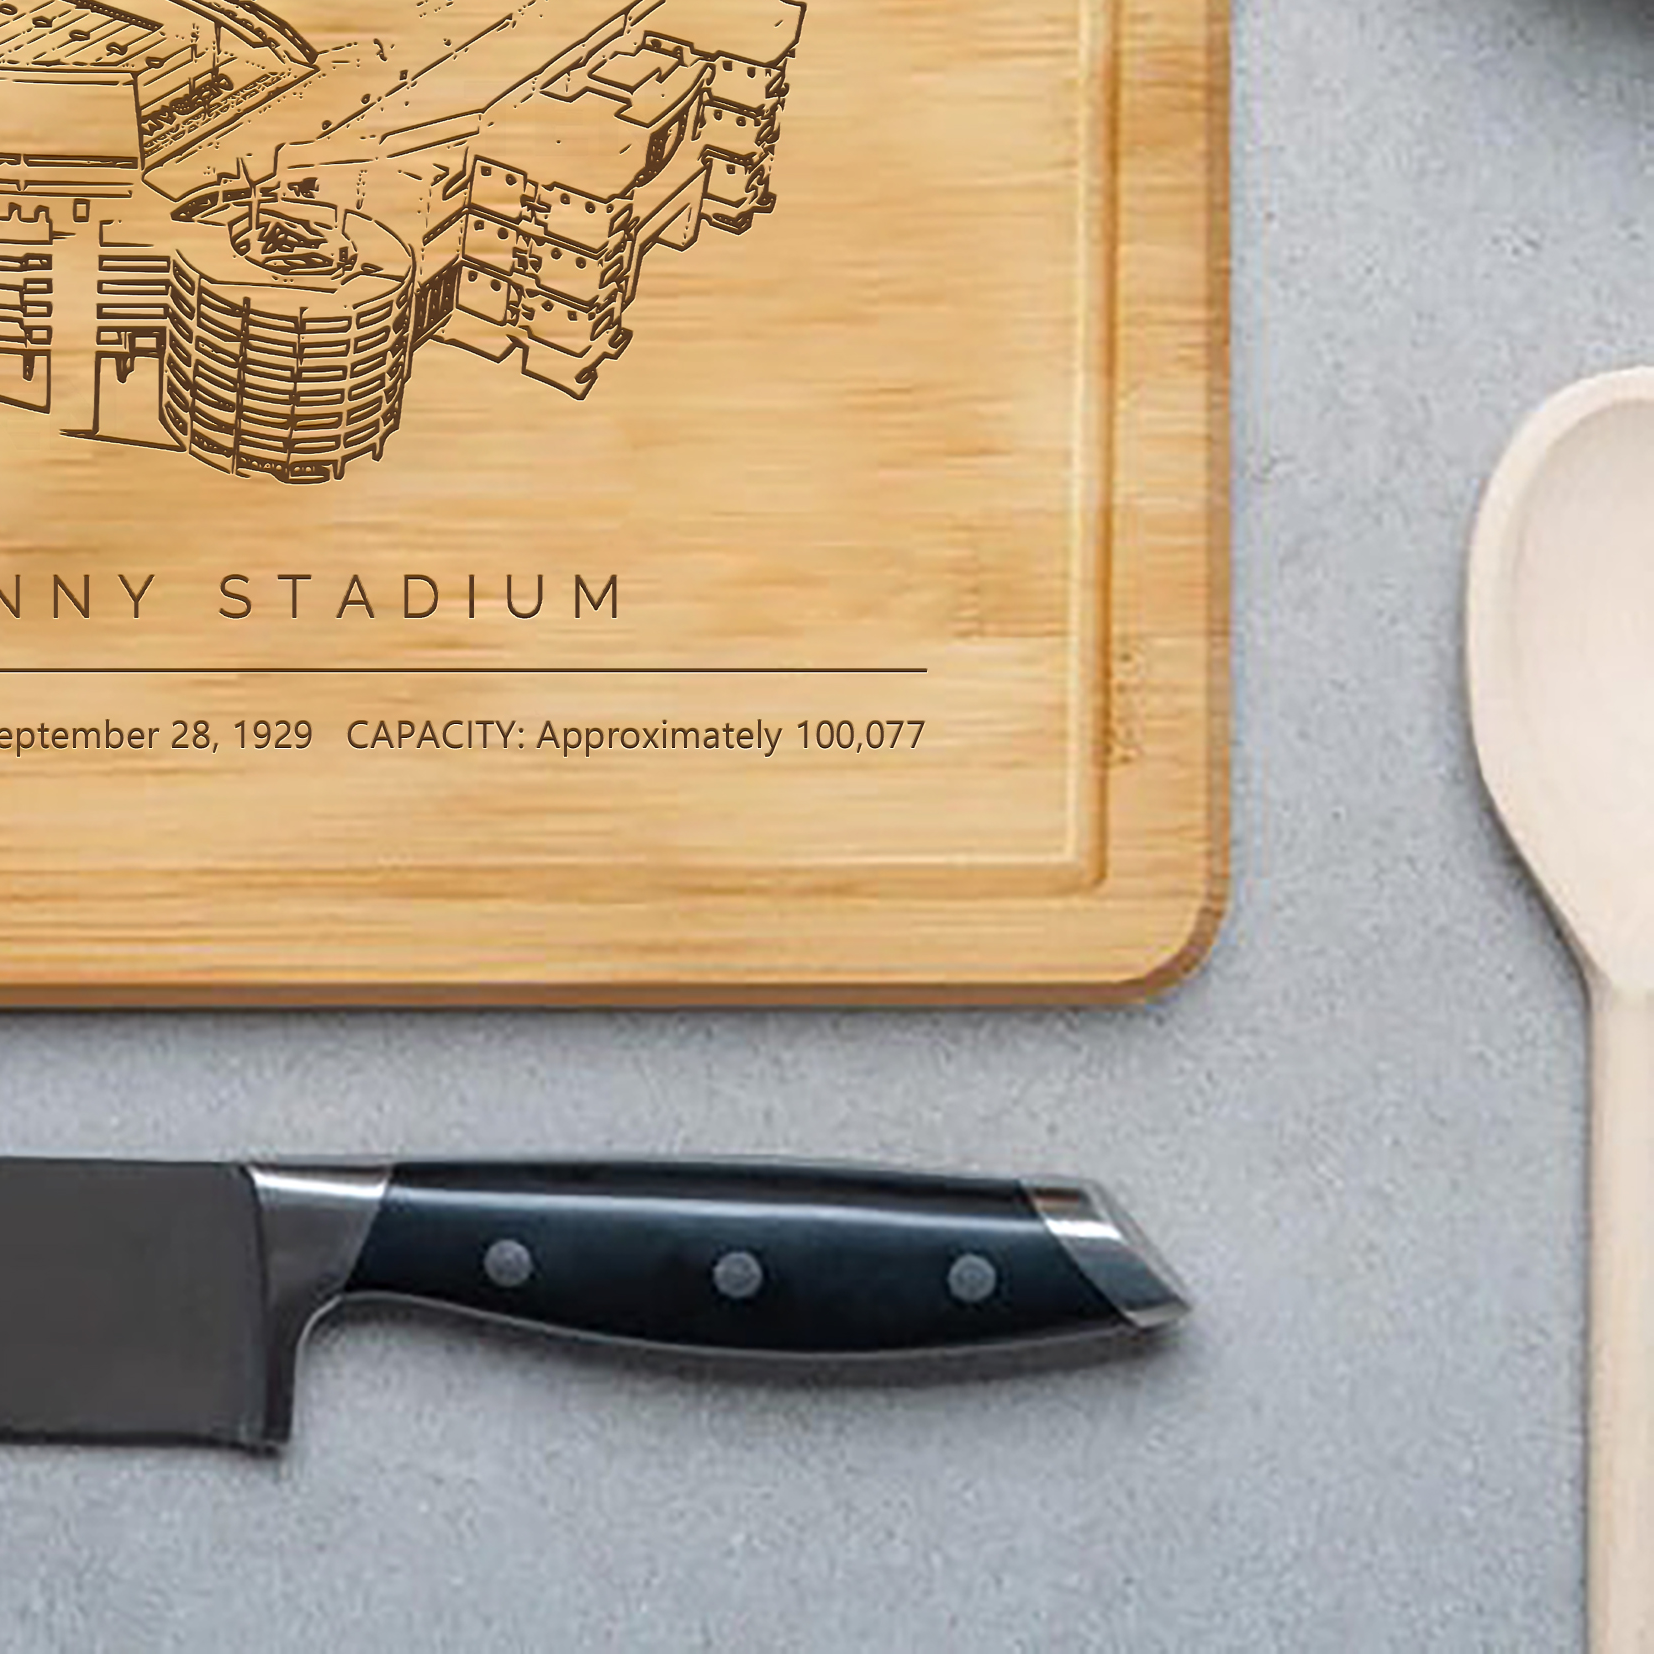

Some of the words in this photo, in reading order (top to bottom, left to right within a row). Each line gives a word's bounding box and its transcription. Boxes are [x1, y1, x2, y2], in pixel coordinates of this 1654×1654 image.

[219, 574, 617, 619] STADIUM
[171, 720, 218, 754] 28,
[234, 720, 312, 749] 1929
[347, 720, 524, 749] CAPACITY:
[536, 719, 783, 758] Approximately
[797, 720, 925, 754] 100,077
